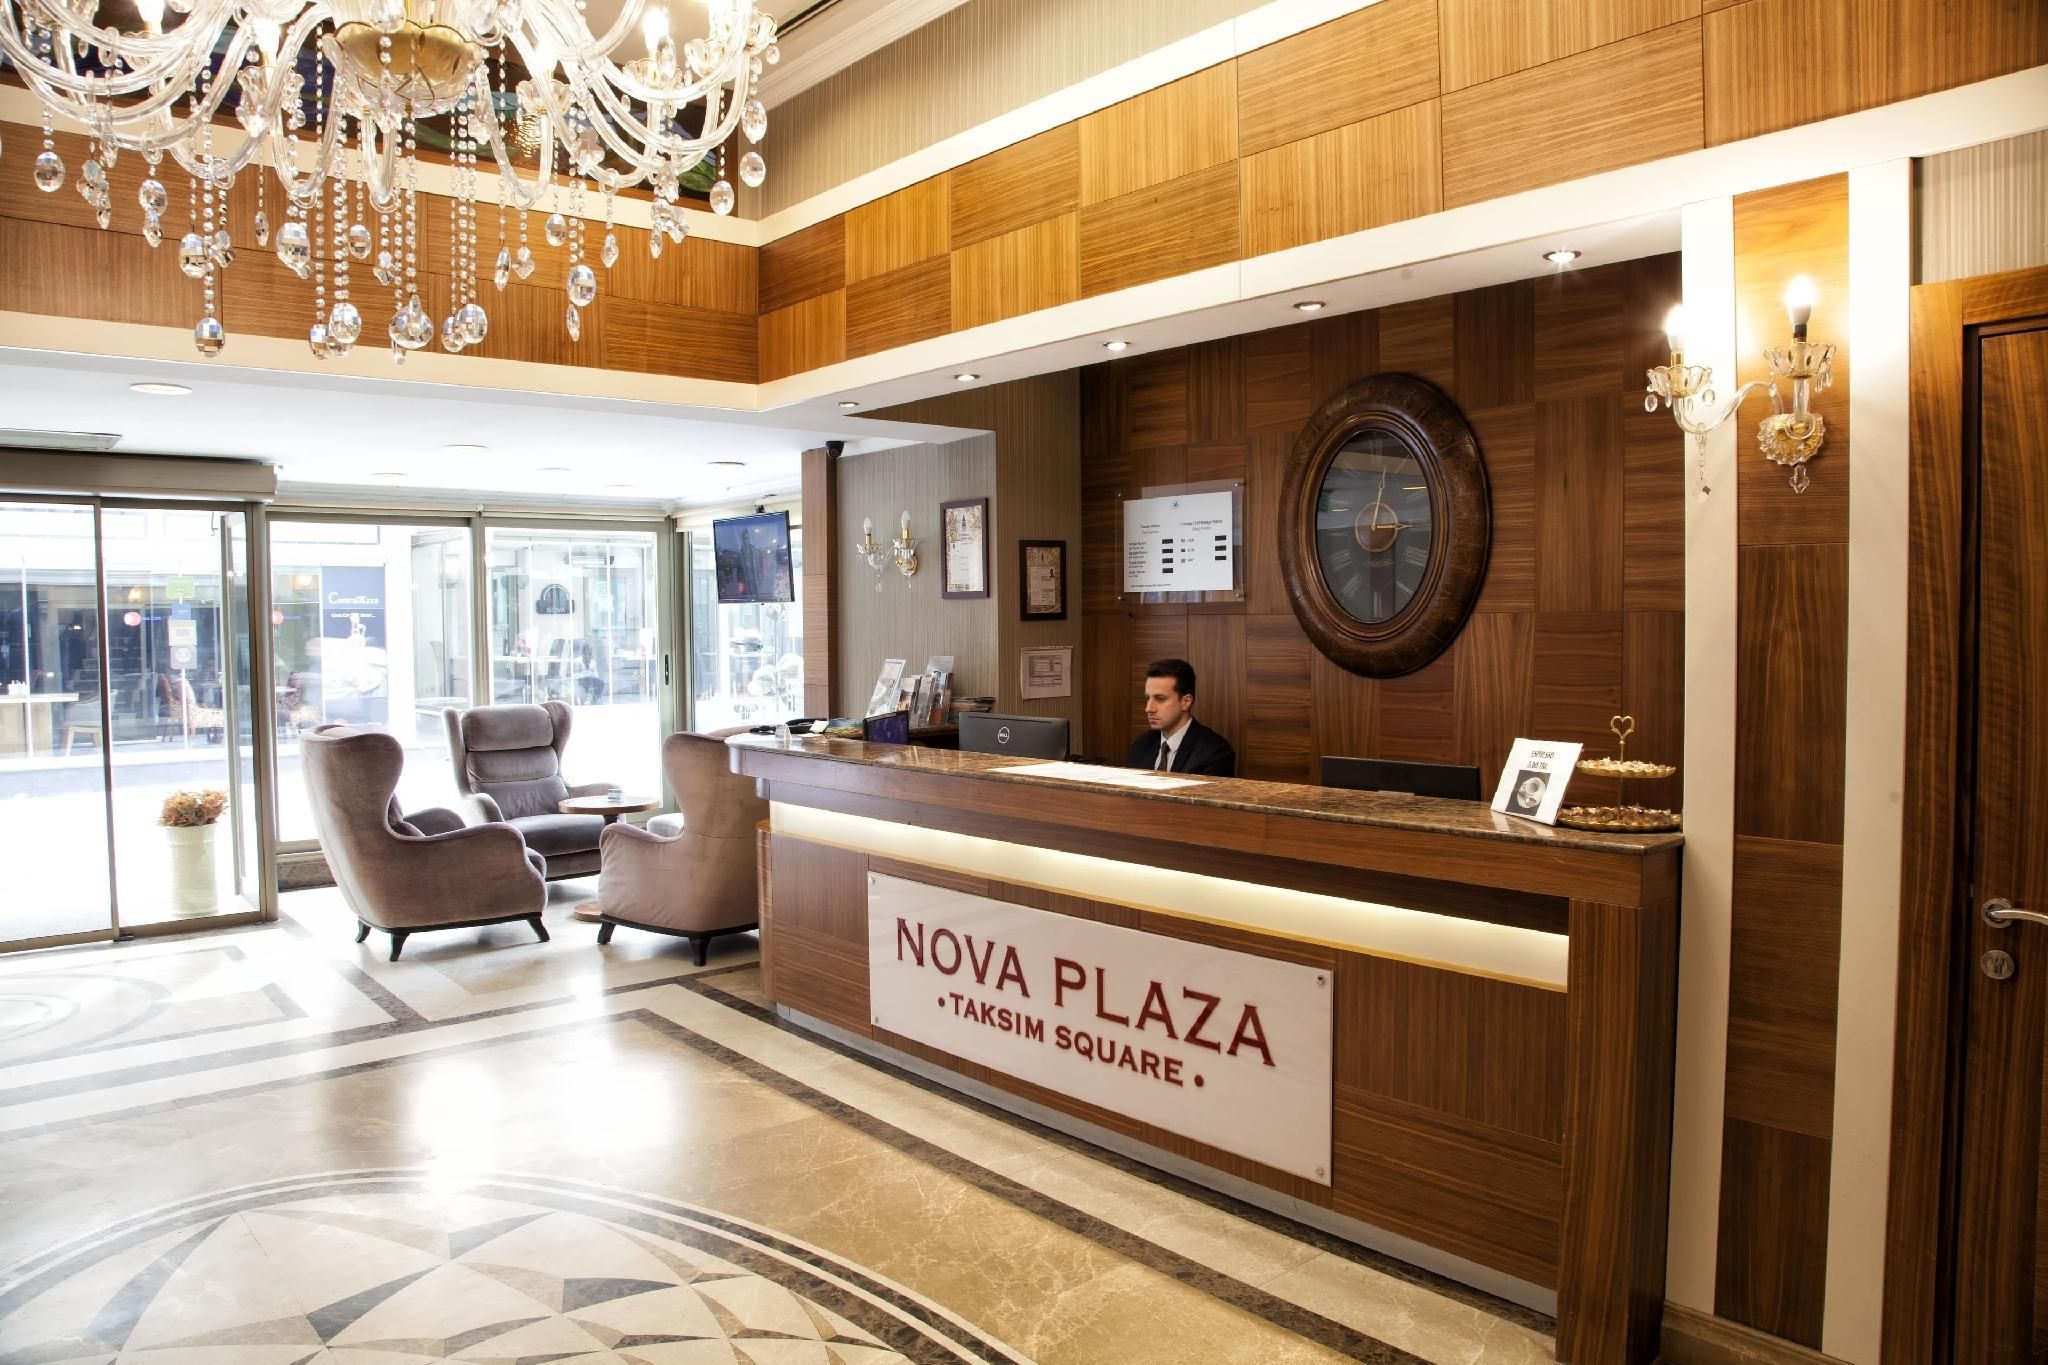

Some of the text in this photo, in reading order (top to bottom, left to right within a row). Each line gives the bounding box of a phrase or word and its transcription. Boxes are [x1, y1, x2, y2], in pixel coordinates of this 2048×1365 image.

[896, 917, 1276, 1067] NOVA PLAZA
[949, 992, 1184, 1088] TAKSIM SQUARE
